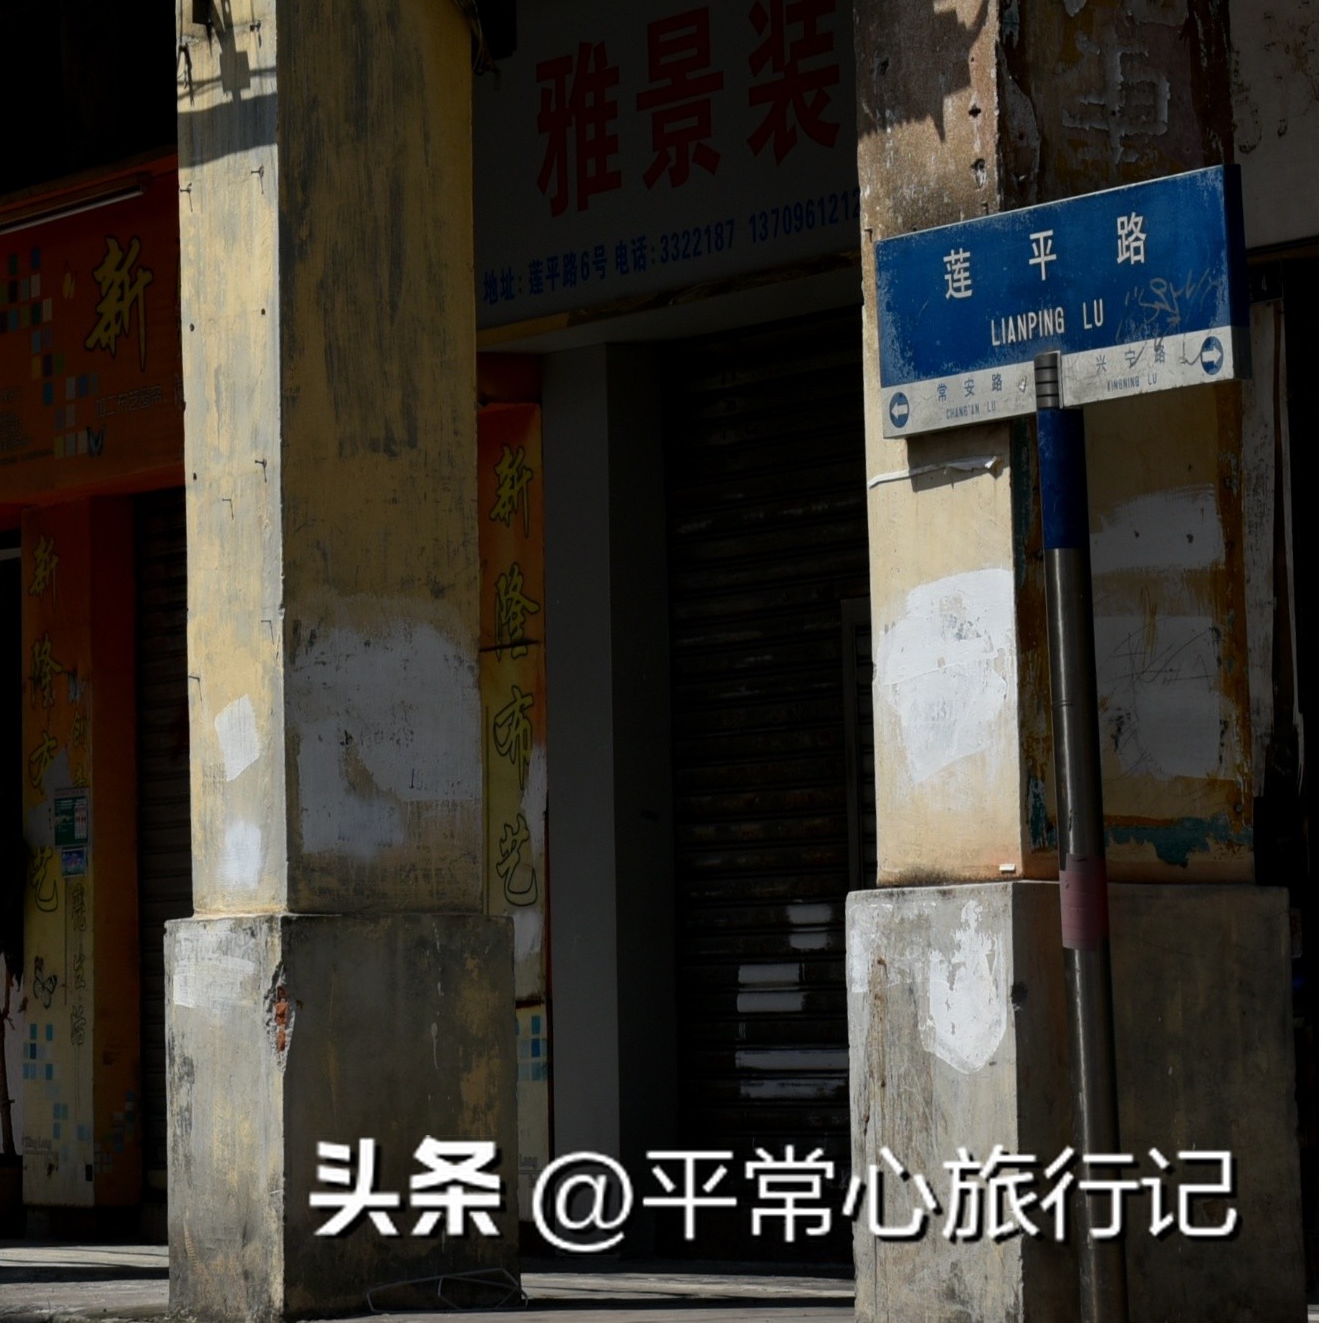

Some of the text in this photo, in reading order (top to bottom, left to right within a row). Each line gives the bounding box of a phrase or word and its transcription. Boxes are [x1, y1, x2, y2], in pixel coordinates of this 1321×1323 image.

[942, 210, 1147, 301] 莲平路
[990, 297, 1105, 348] LIANPING LU
[1094, 347, 1167, 375] 兴宁路
[936, 372, 1004, 403] 常安路
[1146, 371, 1158, 386] LU
[985, 399, 998, 414] LU
